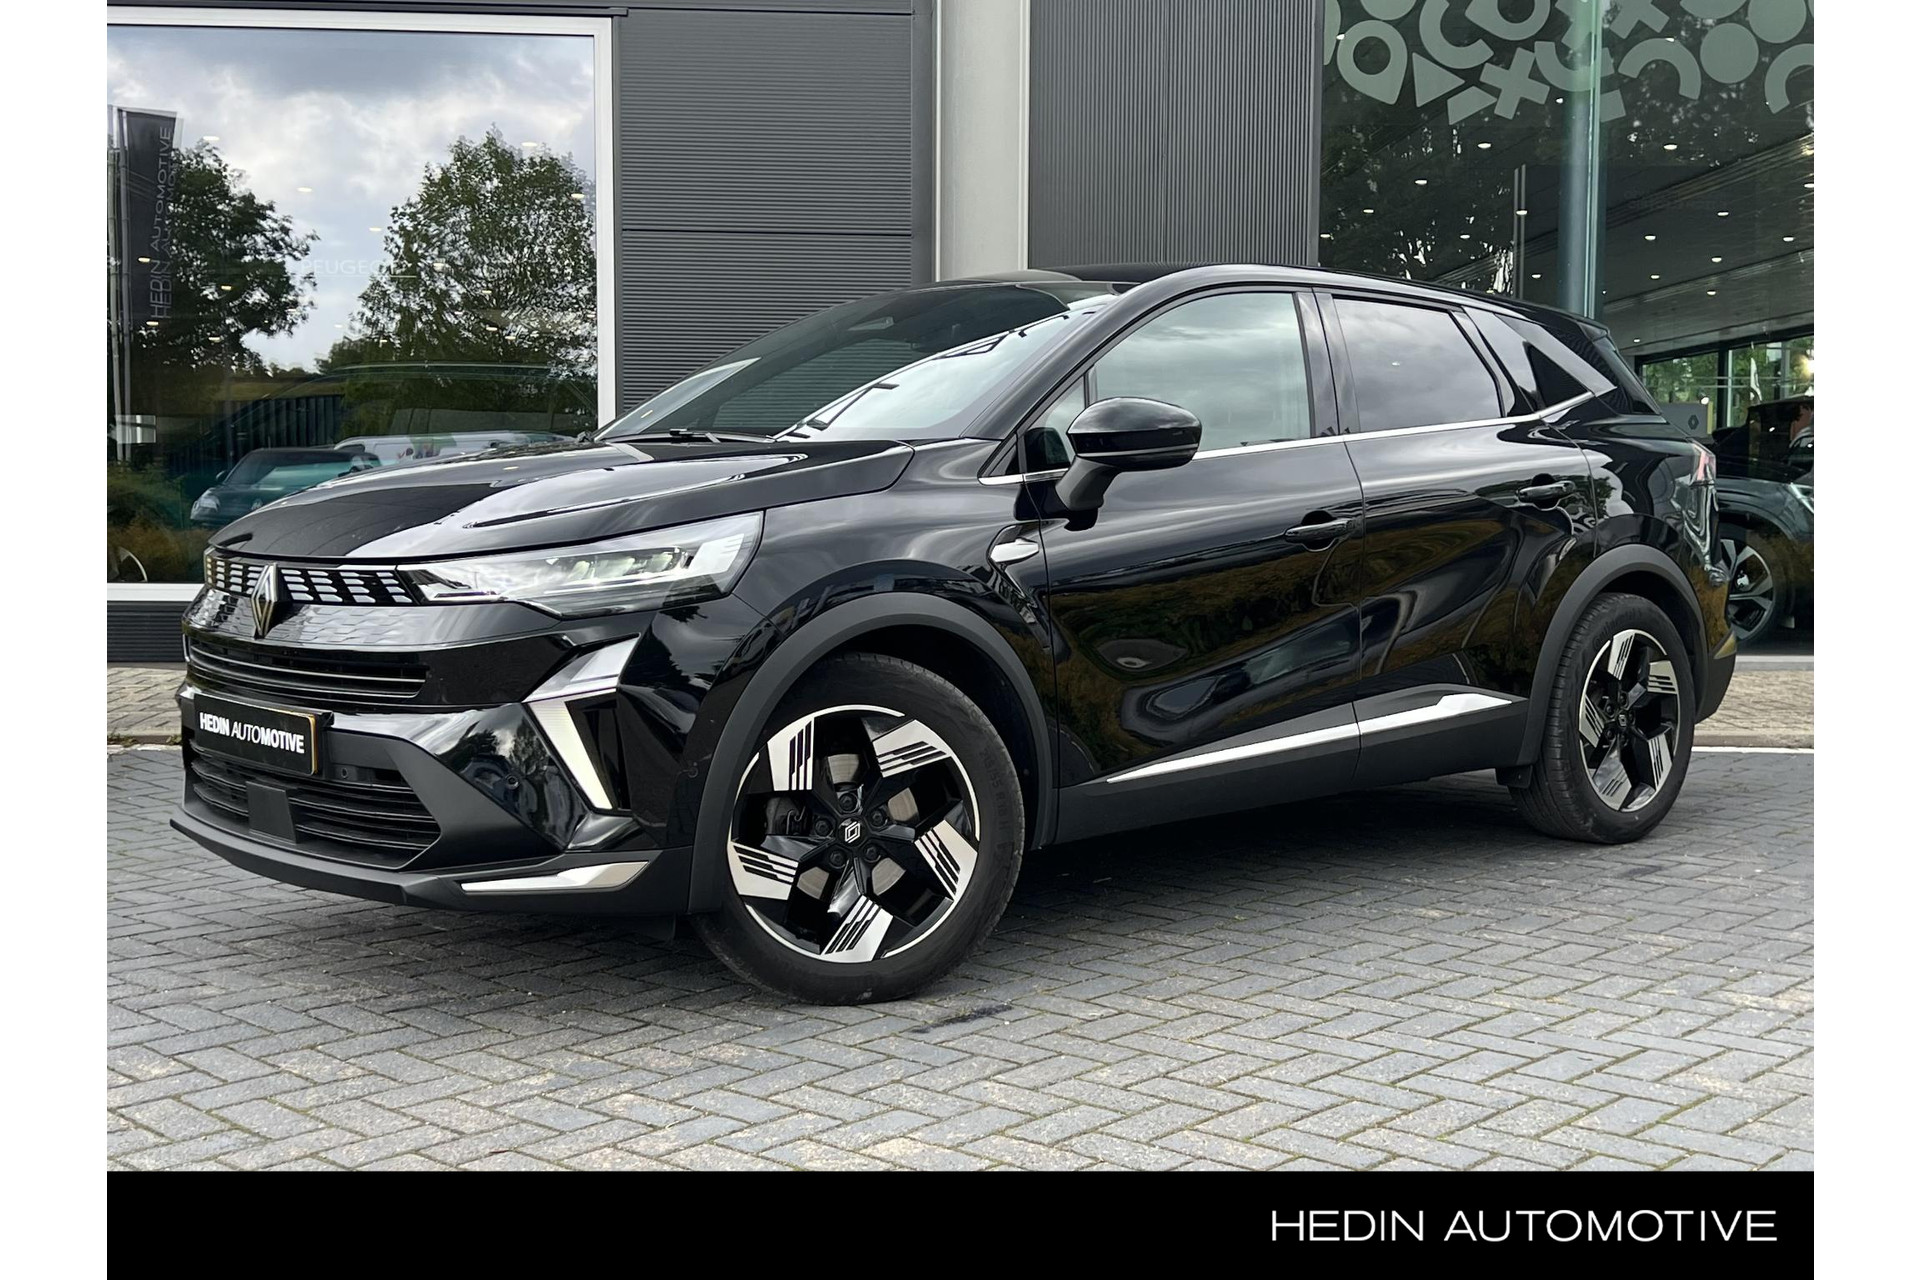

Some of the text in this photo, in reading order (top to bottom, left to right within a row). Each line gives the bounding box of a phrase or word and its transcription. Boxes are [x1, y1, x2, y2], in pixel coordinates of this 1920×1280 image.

[150, 126, 171, 318] HEDIN AUTOMOTIVE
[199, 711, 305, 754] HEDIN AUTOMOTIVE
